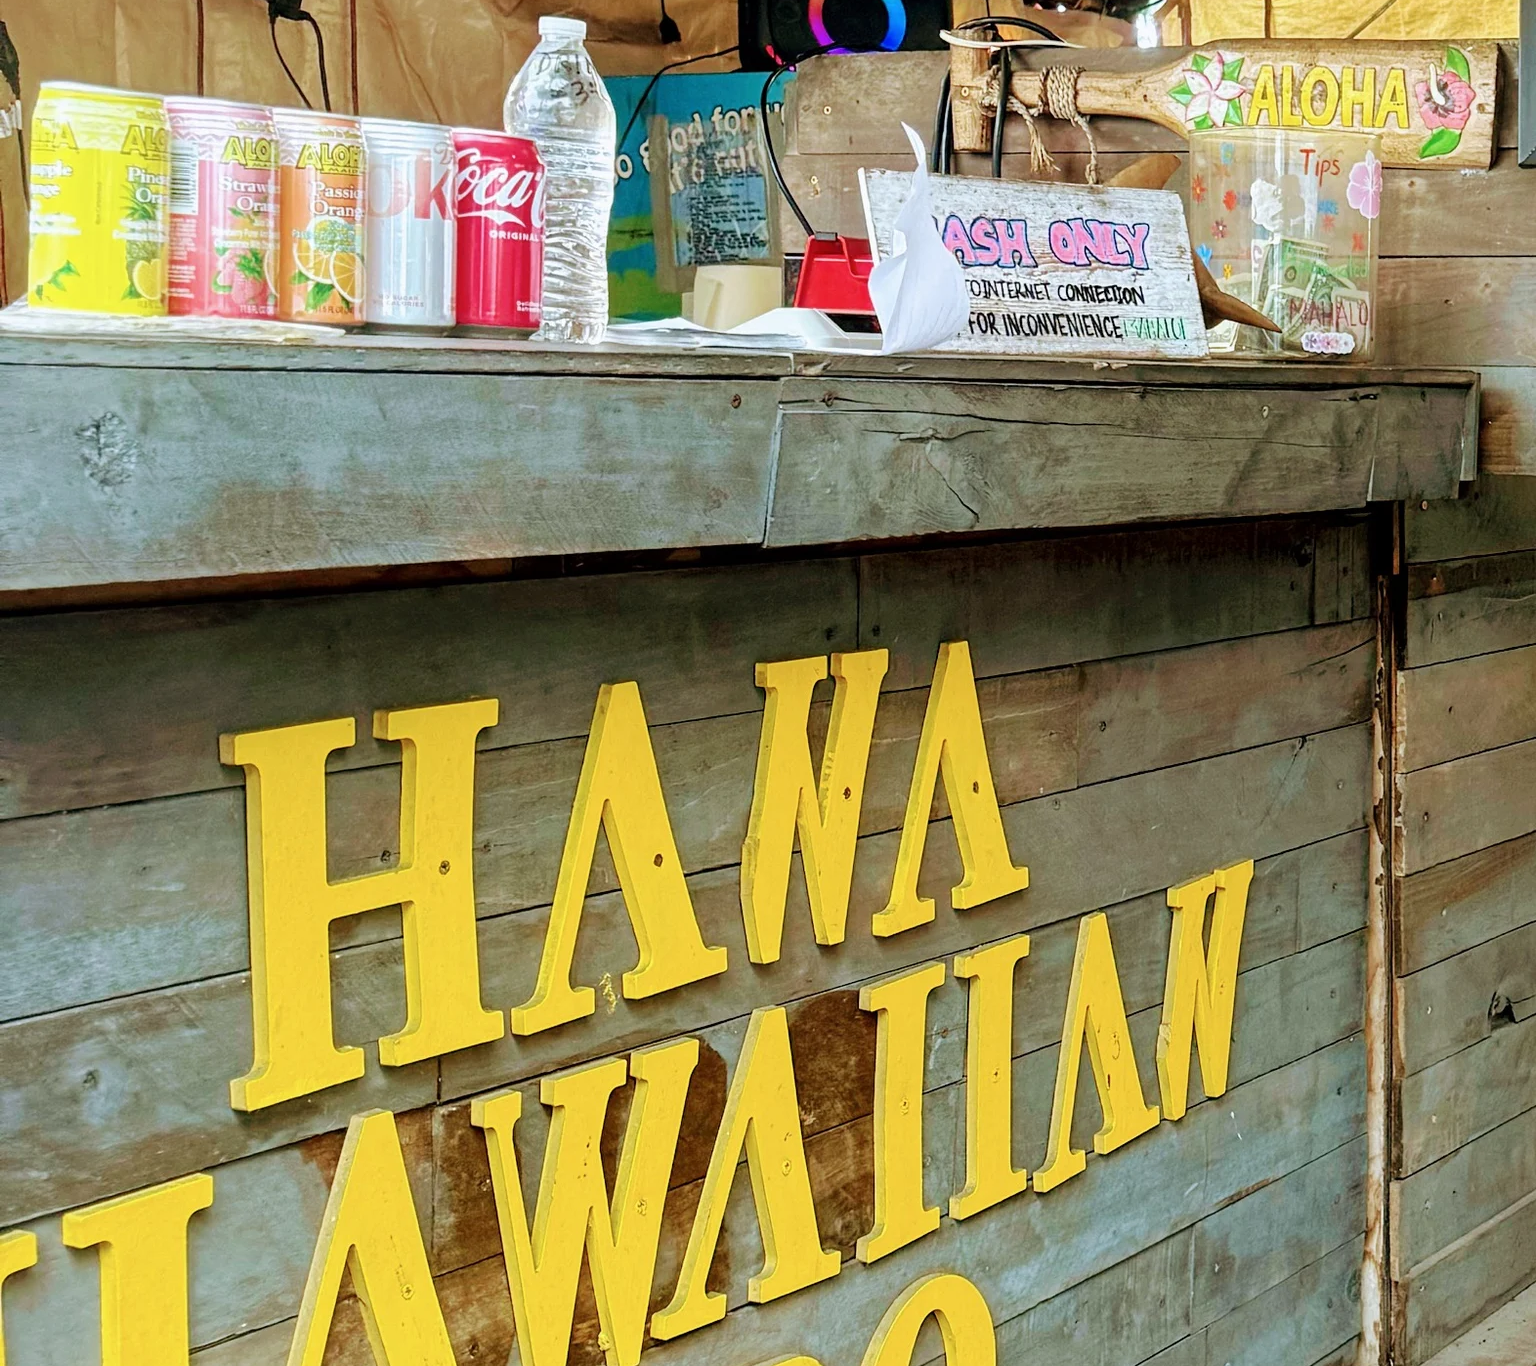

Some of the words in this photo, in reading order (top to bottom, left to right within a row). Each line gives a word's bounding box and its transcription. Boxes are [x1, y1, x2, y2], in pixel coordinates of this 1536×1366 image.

[1247, 62, 1410, 130] ALOHA
[1299, 148, 1341, 187] Tips
[488, 229, 539, 242] ORIGINAL
[932, 213, 1039, 269] ASH
[1050, 217, 1150, 270] ONLY
[982, 279, 1052, 302] INTERNET
[1057, 283, 1146, 305] CONNECTION
[968, 311, 999, 336] FOR
[1001, 312, 1124, 339] INCONVENIENCE
[217, 639, 1031, 1112] HANA
